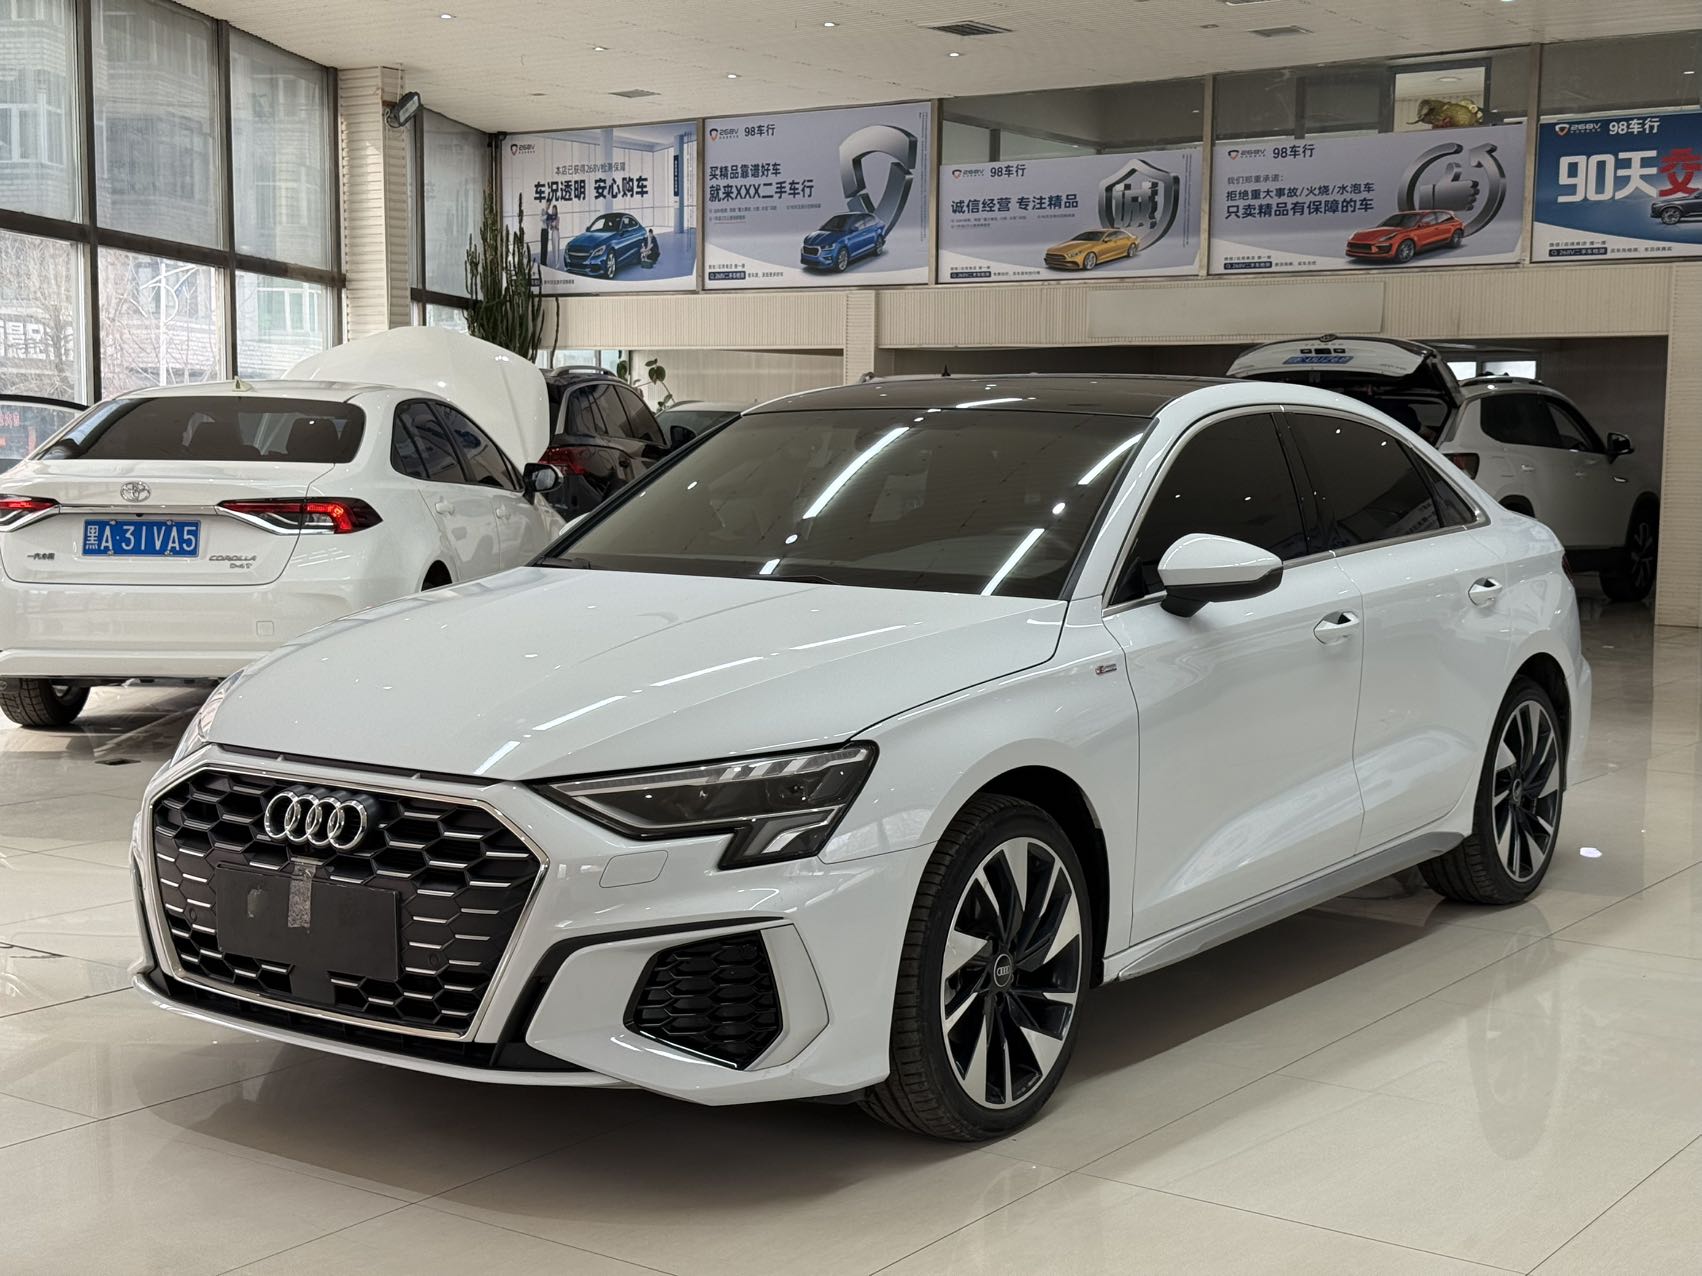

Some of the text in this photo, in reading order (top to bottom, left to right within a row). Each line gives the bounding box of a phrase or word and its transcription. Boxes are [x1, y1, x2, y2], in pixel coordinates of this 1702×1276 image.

[744, 124, 776, 137] 98车行
[1609, 118, 1660, 135] 98车行
[1273, 144, 1315, 159] 98车行
[709, 162, 782, 181] 买精品靠谱好车
[990, 164, 1026, 177] 98车行
[534, 179, 586, 203] 车况透明
[594, 175, 649, 200] 安心购车
[709, 179, 814, 202] 就来XXX二手车行
[1226, 182, 1375, 202] 拒绝重大事故/火烧/水泡车
[951, 193, 1079, 214] 诚信经营 专注精品
[1225, 197, 1374, 219] 只卖精品有保障的车
